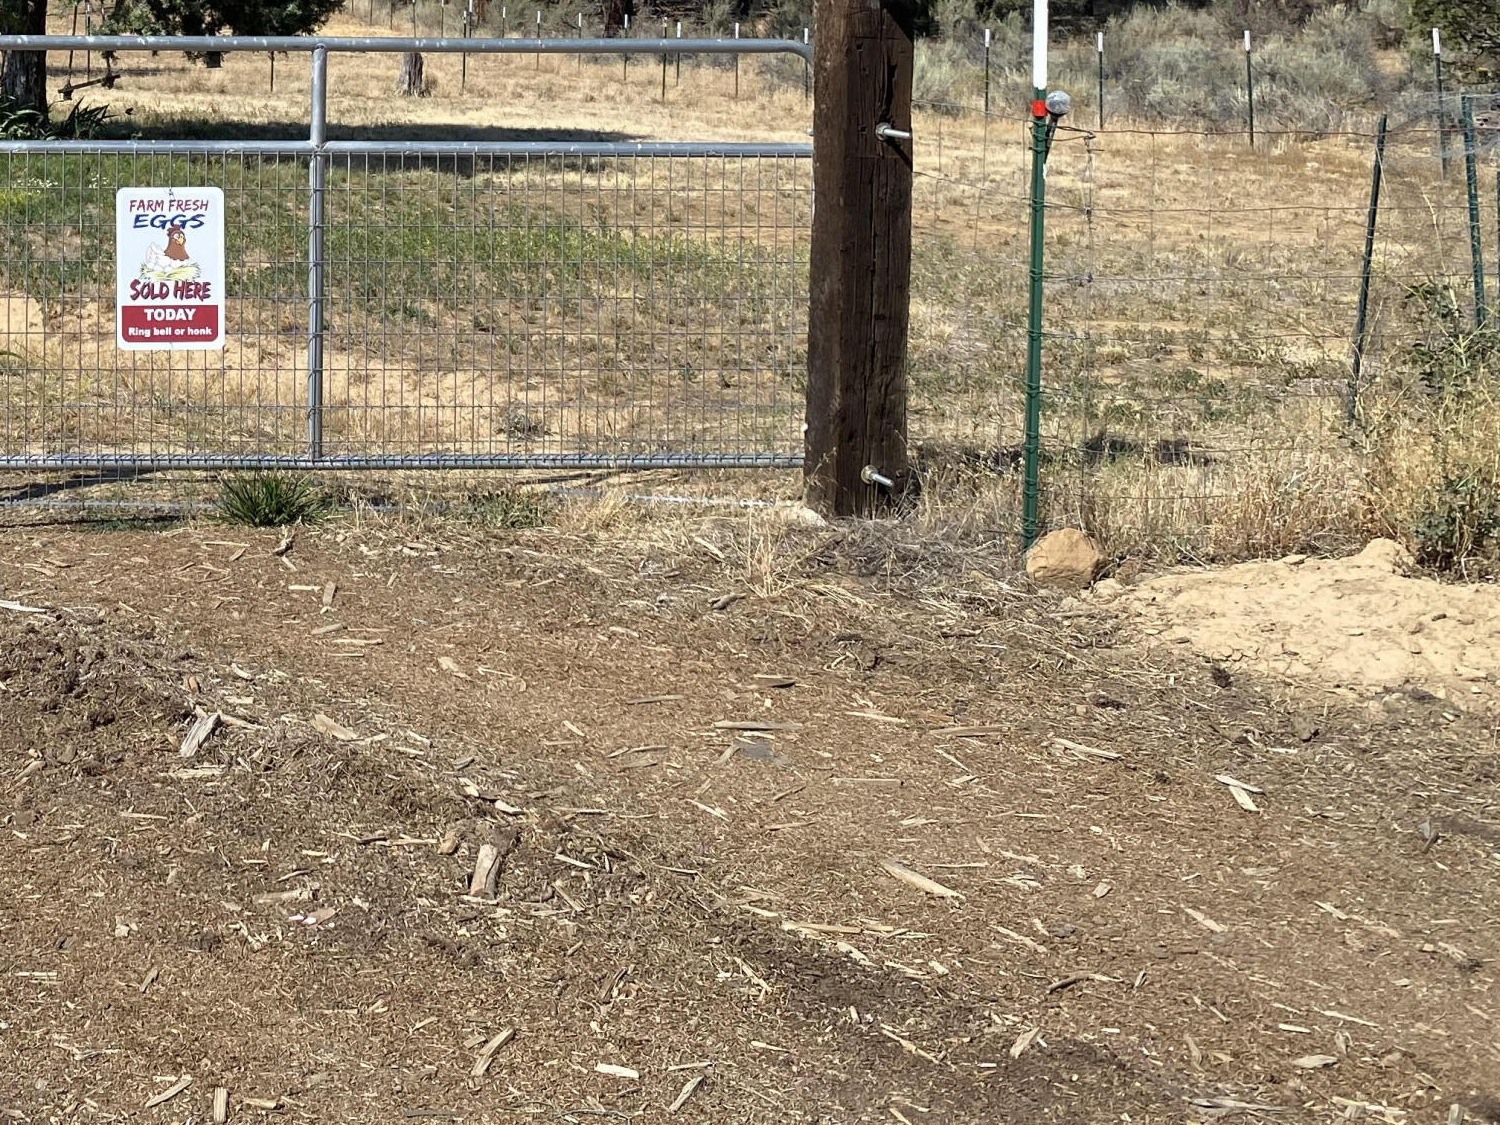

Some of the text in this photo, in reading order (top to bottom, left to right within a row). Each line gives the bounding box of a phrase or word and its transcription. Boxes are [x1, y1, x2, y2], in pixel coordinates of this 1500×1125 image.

[129, 199, 209, 212] FARM FRESH
[133, 214, 205, 230] EGGS
[130, 279, 212, 302] SOLD HERE
[144, 308, 196, 321] TODAY
[128, 326, 212, 338] Ring bell or honk
